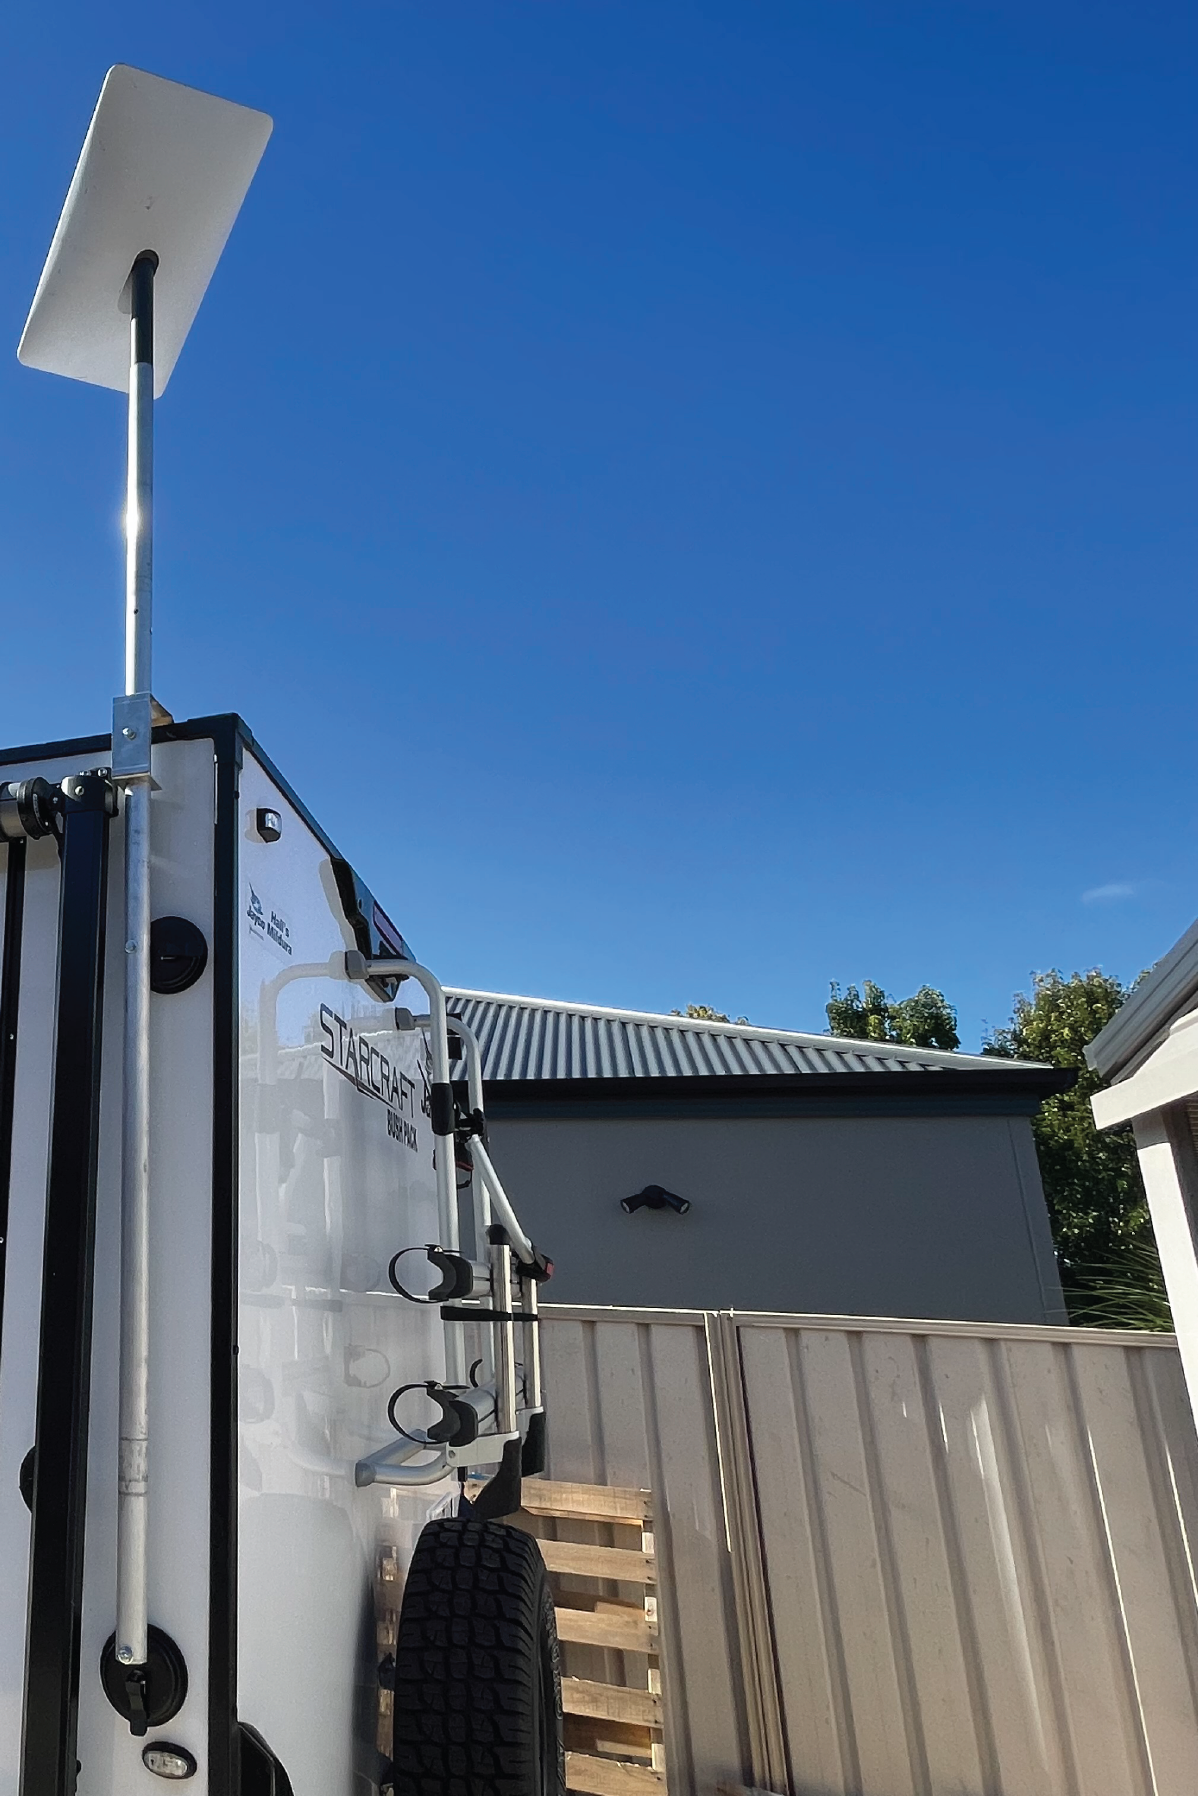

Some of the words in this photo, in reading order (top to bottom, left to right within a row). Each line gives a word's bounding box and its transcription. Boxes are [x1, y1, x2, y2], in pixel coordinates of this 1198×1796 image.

[266, 922, 292, 956] Mildura
[320, 1002, 416, 1119] STARCRAFT
[386, 1108, 403, 1143] BUSH
[403, 1120, 418, 1153] PACK
